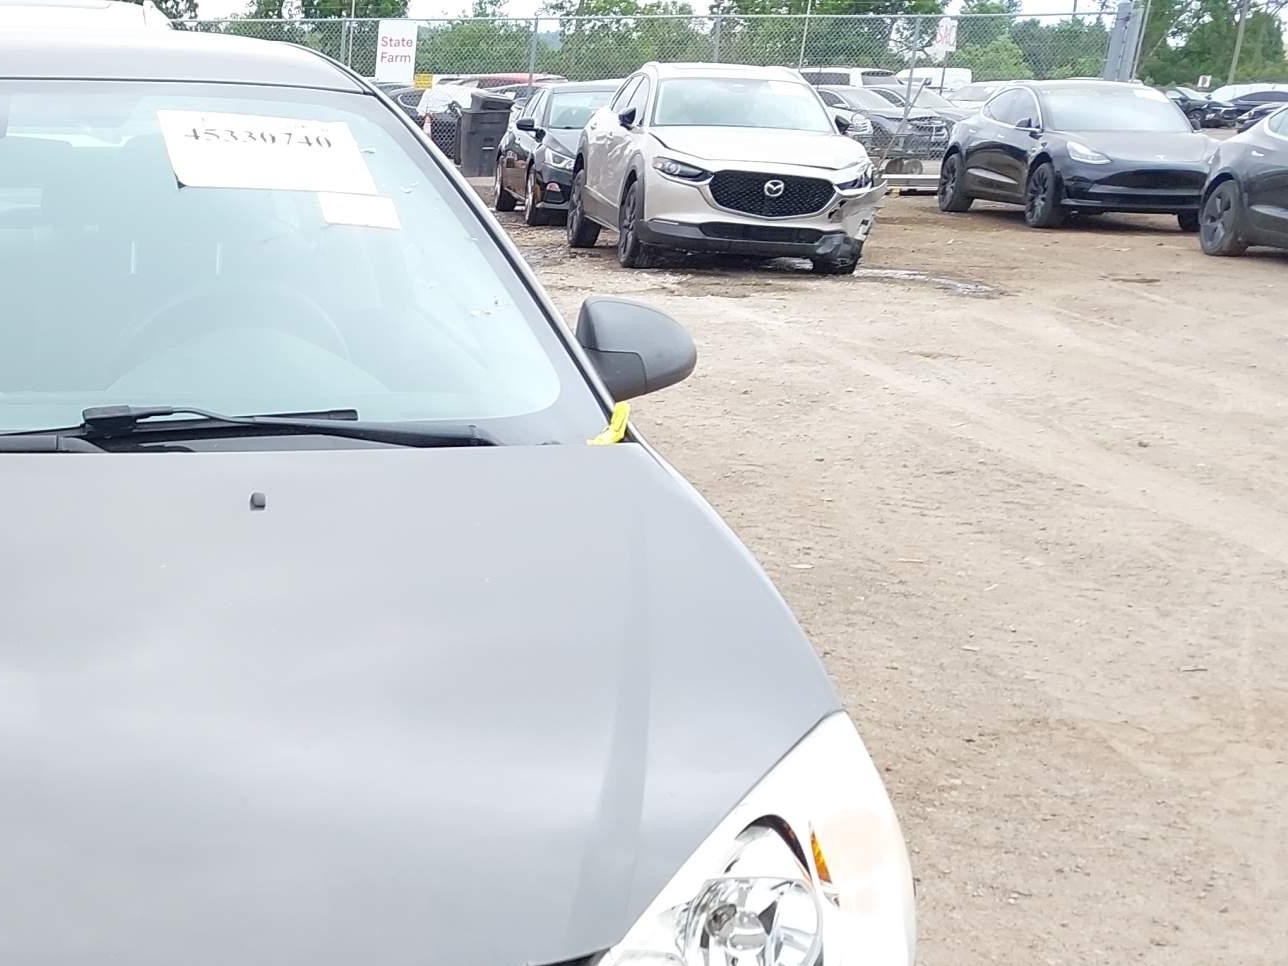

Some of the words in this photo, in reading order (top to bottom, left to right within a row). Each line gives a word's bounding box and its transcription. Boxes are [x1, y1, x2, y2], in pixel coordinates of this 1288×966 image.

[380, 36, 413, 48] State
[380, 52, 411, 63] Farm
[184, 127, 333, 149] 45330740
